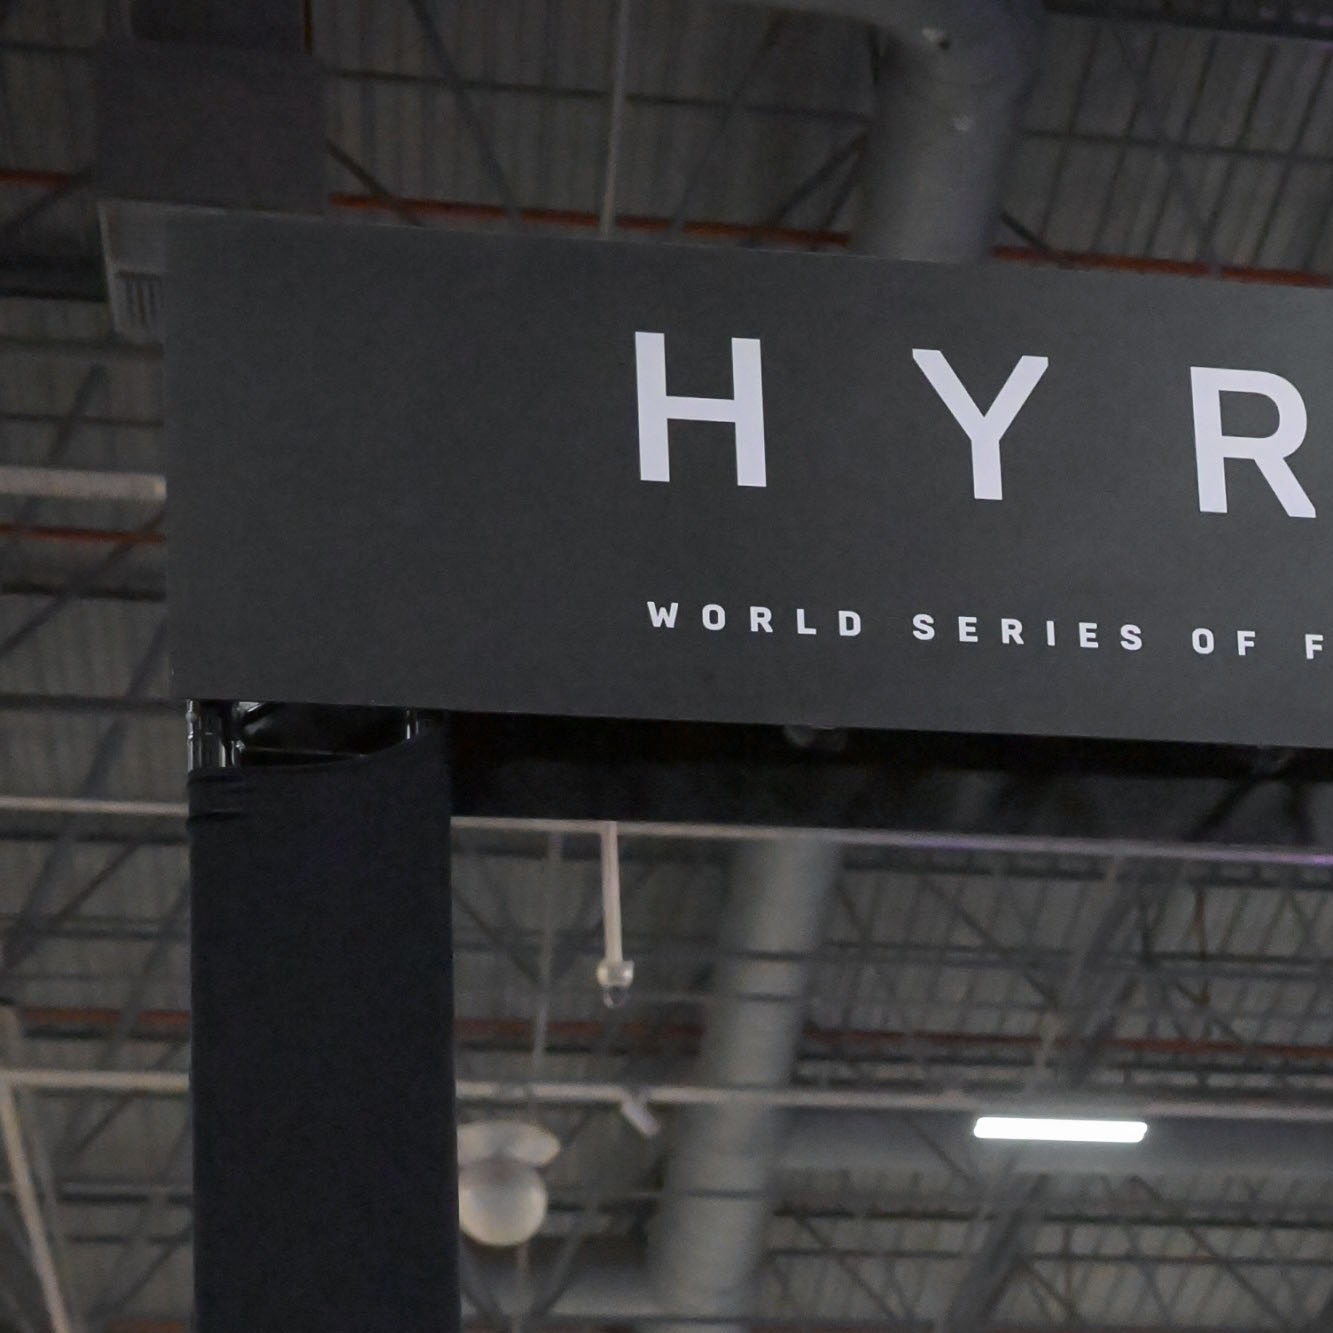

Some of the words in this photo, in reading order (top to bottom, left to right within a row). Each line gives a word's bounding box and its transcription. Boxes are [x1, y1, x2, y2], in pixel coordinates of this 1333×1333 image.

[647, 602, 861, 637] WORLD
[912, 614, 1142, 651] SERIES
[1192, 628, 1256, 656] OF
